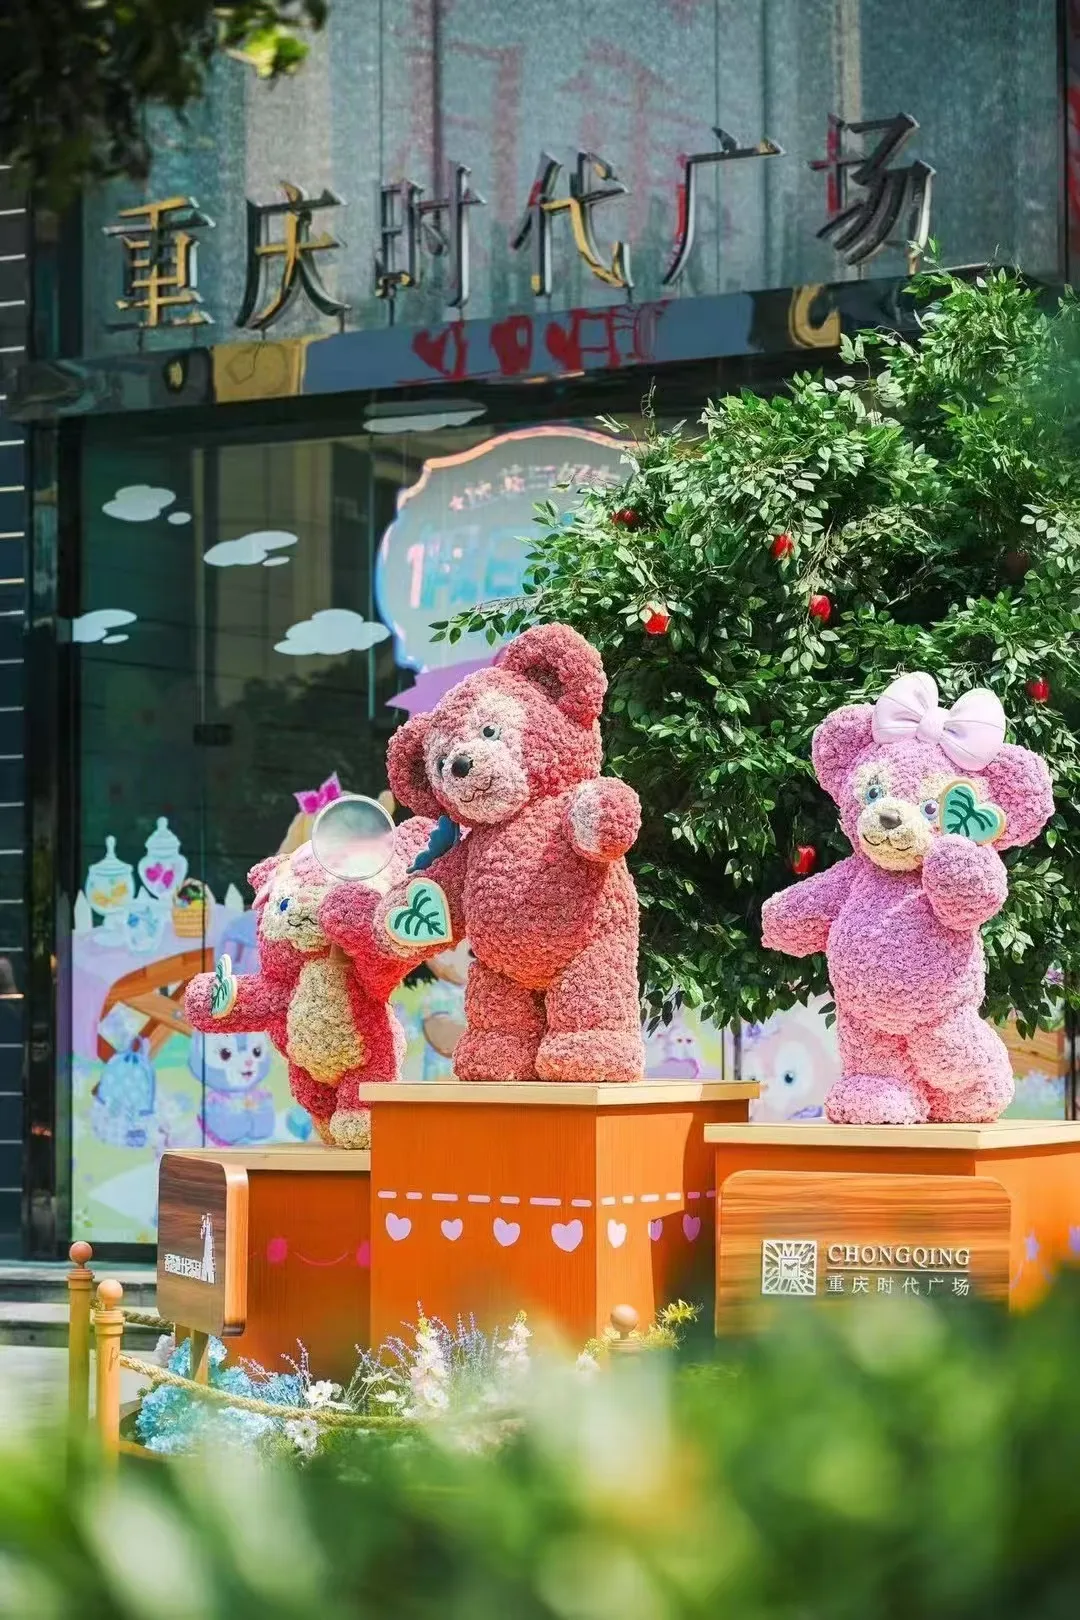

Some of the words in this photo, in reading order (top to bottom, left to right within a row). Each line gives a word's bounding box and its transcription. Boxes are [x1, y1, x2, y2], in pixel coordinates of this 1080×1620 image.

[102, 112, 936, 329] 重庆时代广场
[827, 1243, 971, 1268] CHONGQING
[826, 1274, 970, 1296] 重庆时代广场
